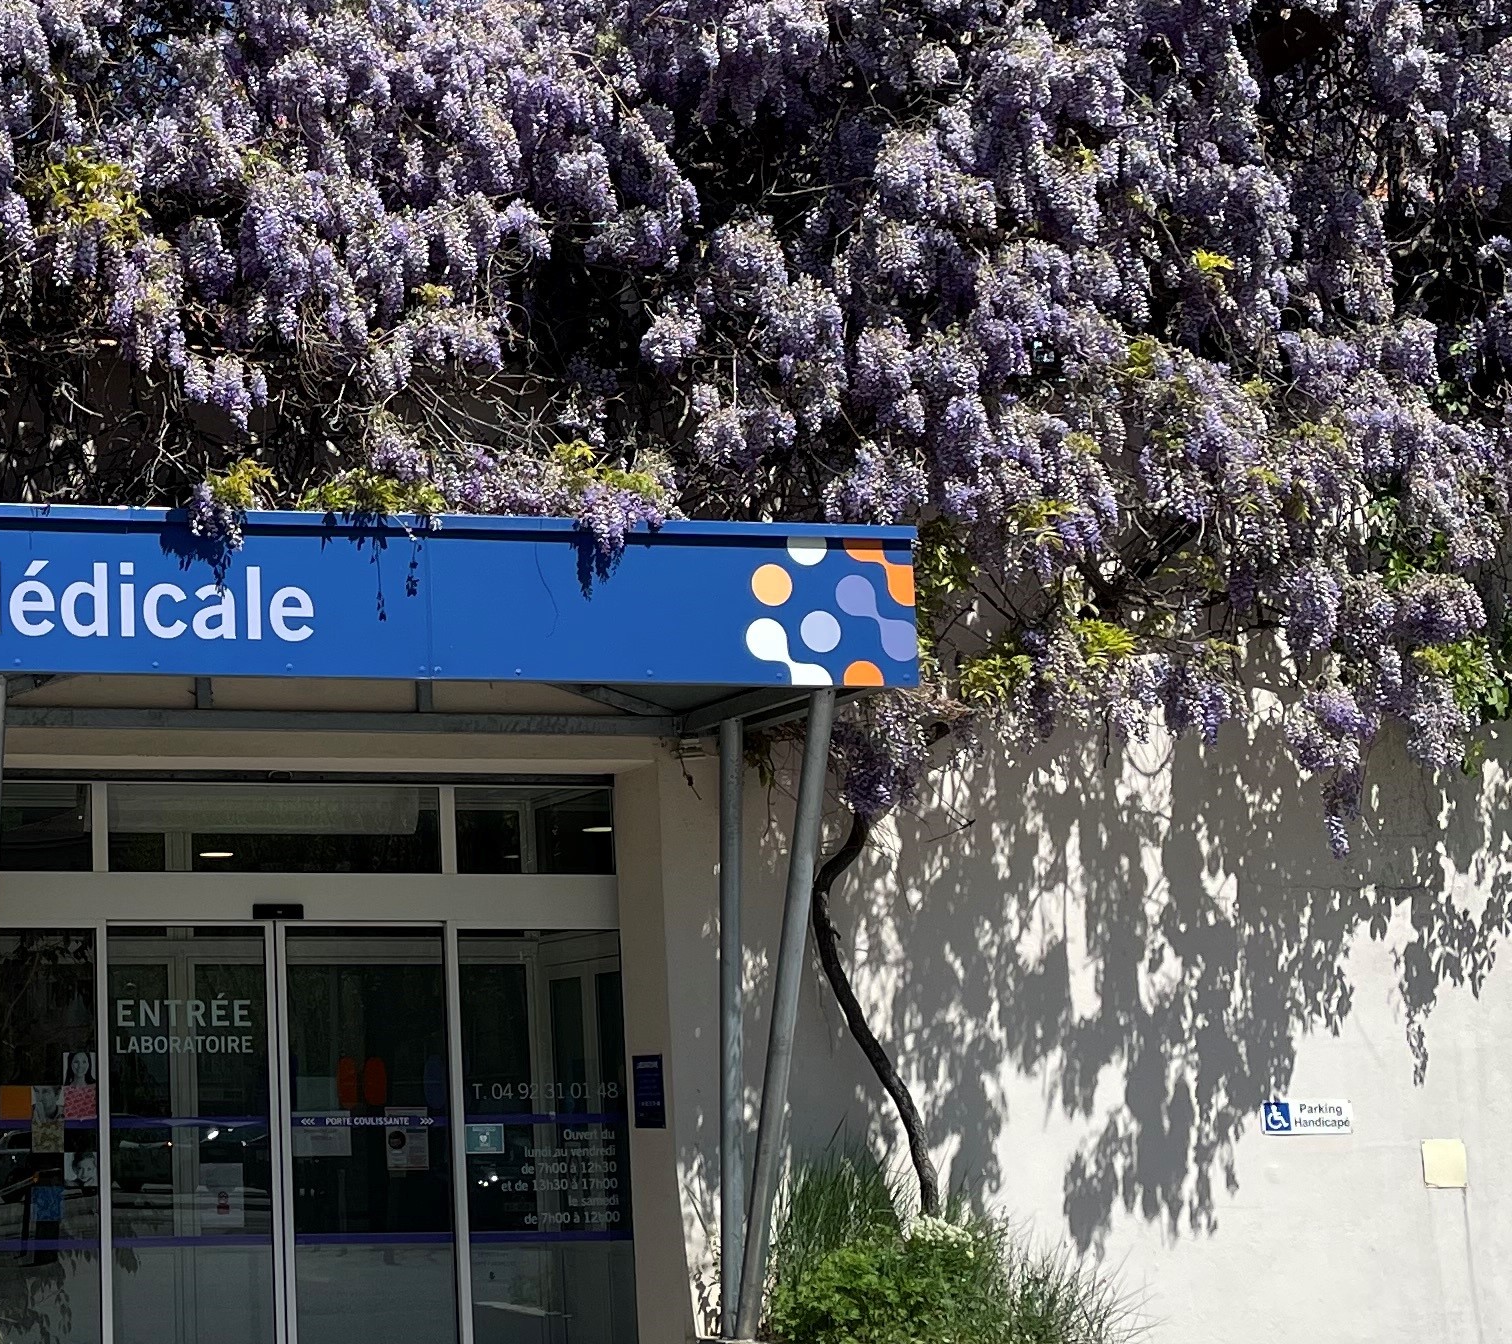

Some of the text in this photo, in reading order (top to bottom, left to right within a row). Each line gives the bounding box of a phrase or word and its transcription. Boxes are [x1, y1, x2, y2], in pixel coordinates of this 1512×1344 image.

[116, 992, 252, 1028] ENTRÉE
[115, 1035, 254, 1055] LABORATOIRE
[471, 1082, 488, 1100] T.
[491, 1082, 514, 1100] 04
[517, 1082, 539, 1100] 92
[544, 1082, 565, 1099] 31
[569, 1082, 591, 1099] 01
[597, 1081, 619, 1099] 48
[1299, 1103, 1343, 1117] Parking
[325, 1116, 410, 1126] PORTE COULISSANTE
[1294, 1117, 1351, 1130] Handicapé
[563, 1128, 615, 1141] Ouvert du
[524, 1144, 616, 1158] lundi au vendredi
[521, 1161, 617, 1175] de 7h00 à 12h30
[501, 1177, 618, 1192] et de 13h30 à 17h00
[568, 1193, 619, 1207] le samedi
[524, 1210, 620, 1225] de 7h00 à 12h00
